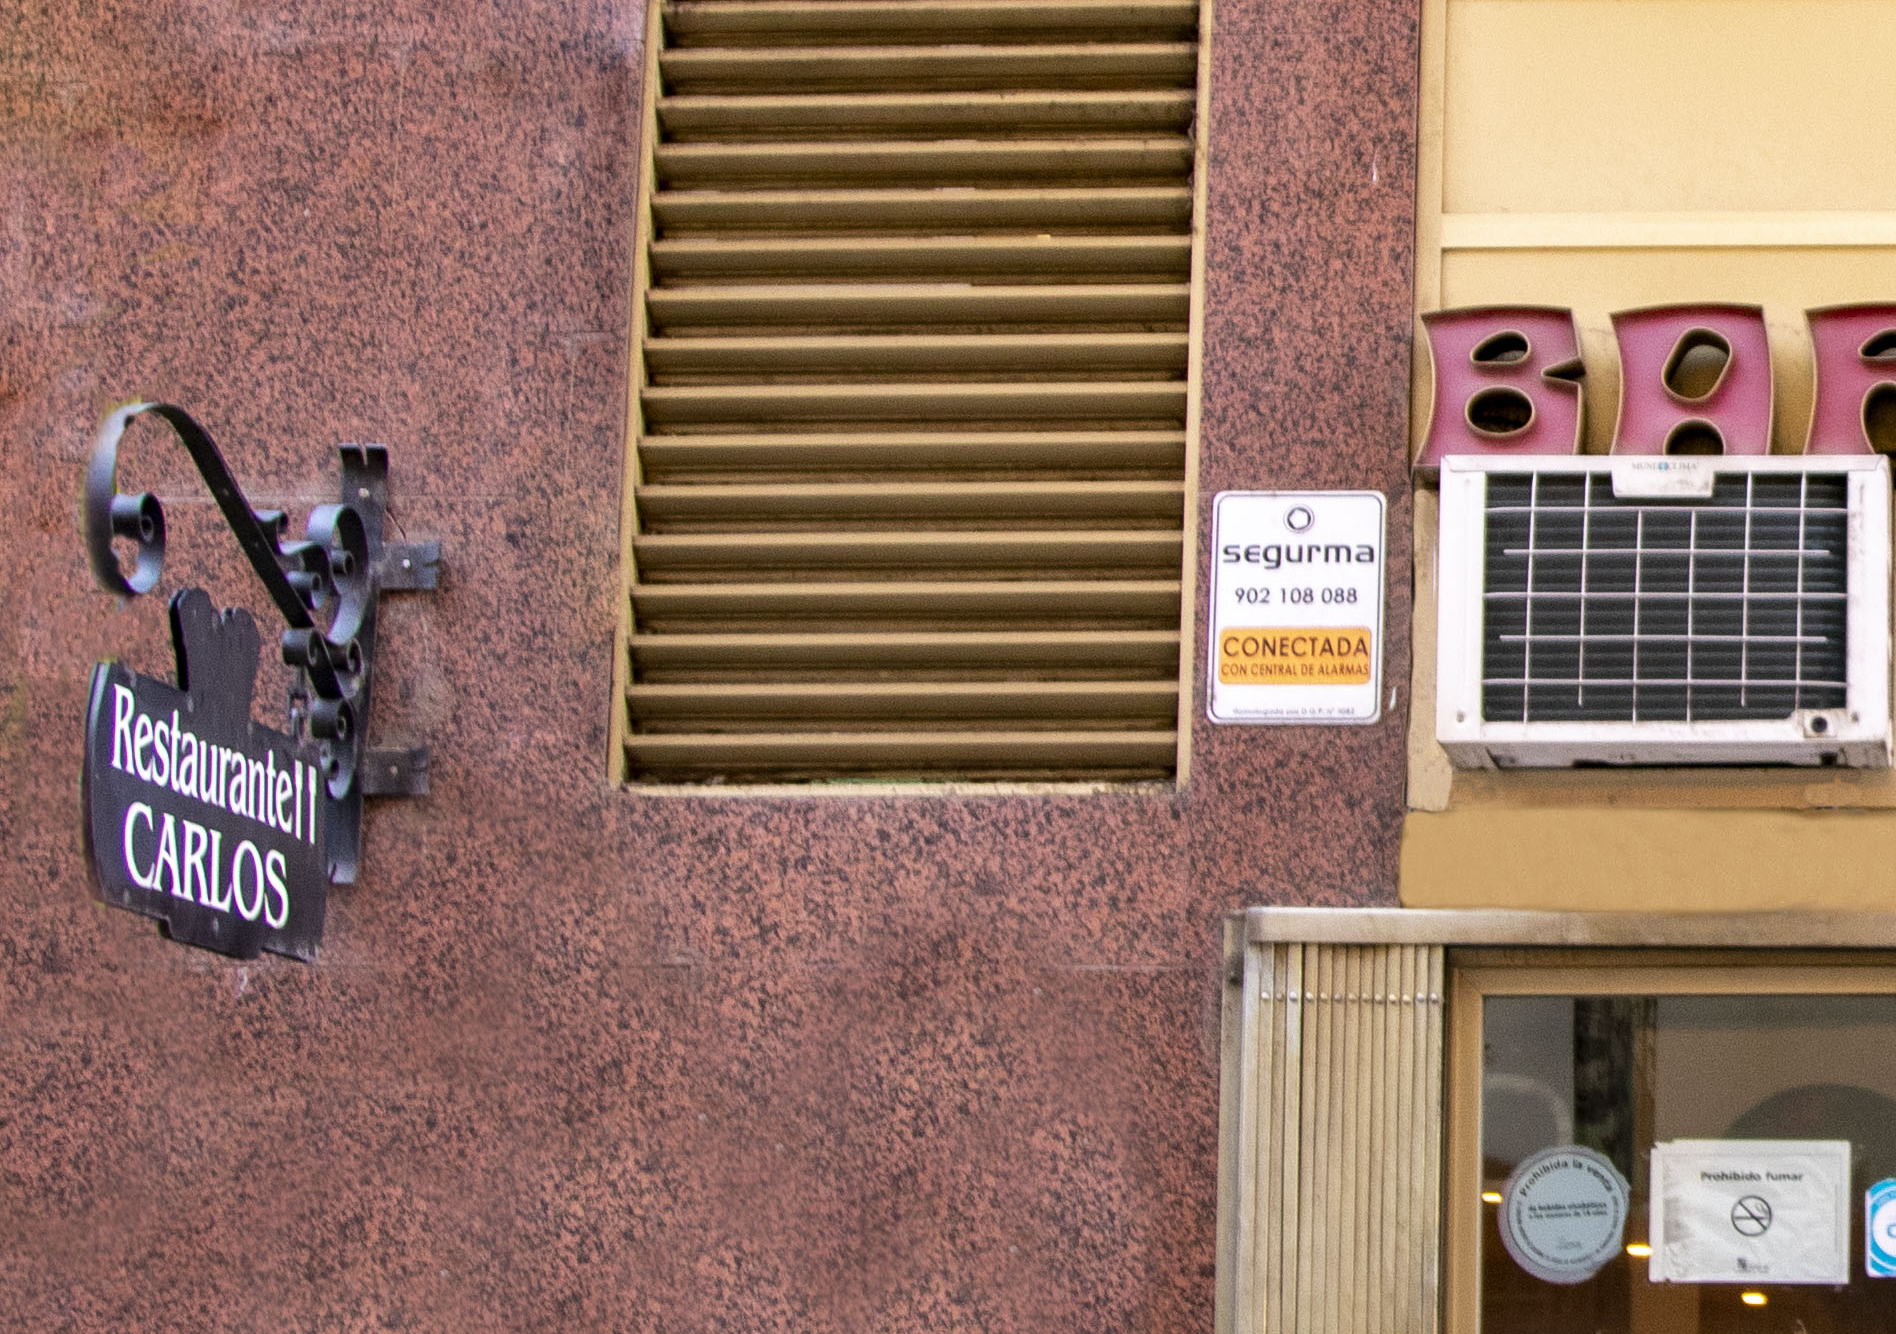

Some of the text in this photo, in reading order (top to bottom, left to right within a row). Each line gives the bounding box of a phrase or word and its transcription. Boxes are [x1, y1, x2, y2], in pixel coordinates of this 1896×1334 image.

[1223, 544, 1375, 569] segurma
[1235, 587, 1358, 605] 902 108 088
[1223, 636, 1369, 657] CONECTADA
[1221, 662, 1369, 676] CON CENTRAL DE ALARMAS
[123, 801, 290, 929] CARLOS
[1519, 1158, 1568, 1197] Prohibida
[1700, 1170, 1803, 1182] Prohibido fumar
